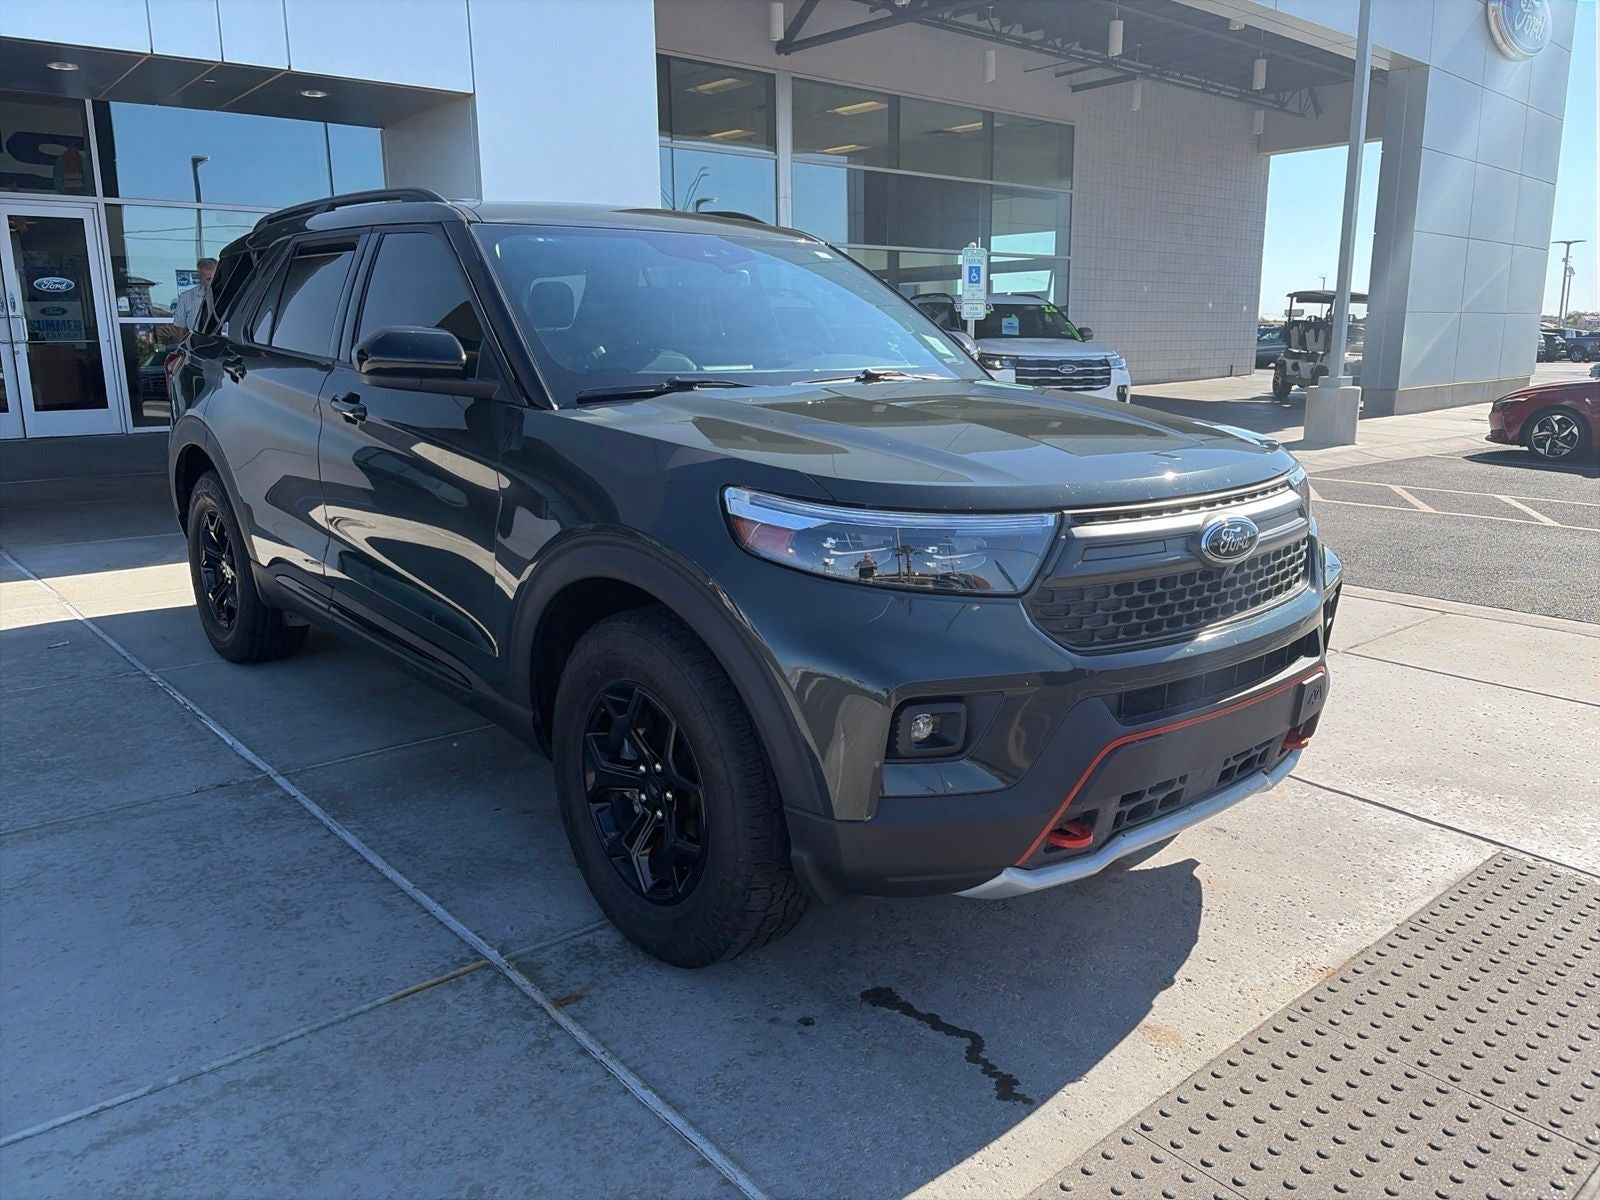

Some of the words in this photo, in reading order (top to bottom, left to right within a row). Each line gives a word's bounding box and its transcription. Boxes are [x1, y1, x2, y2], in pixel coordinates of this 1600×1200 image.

[1514, 0, 1546, 41] Ford
[42, 280, 67, 290] Ford
[30, 319, 82, 332] SUMMER
[1220, 526, 1250, 554] Ford
